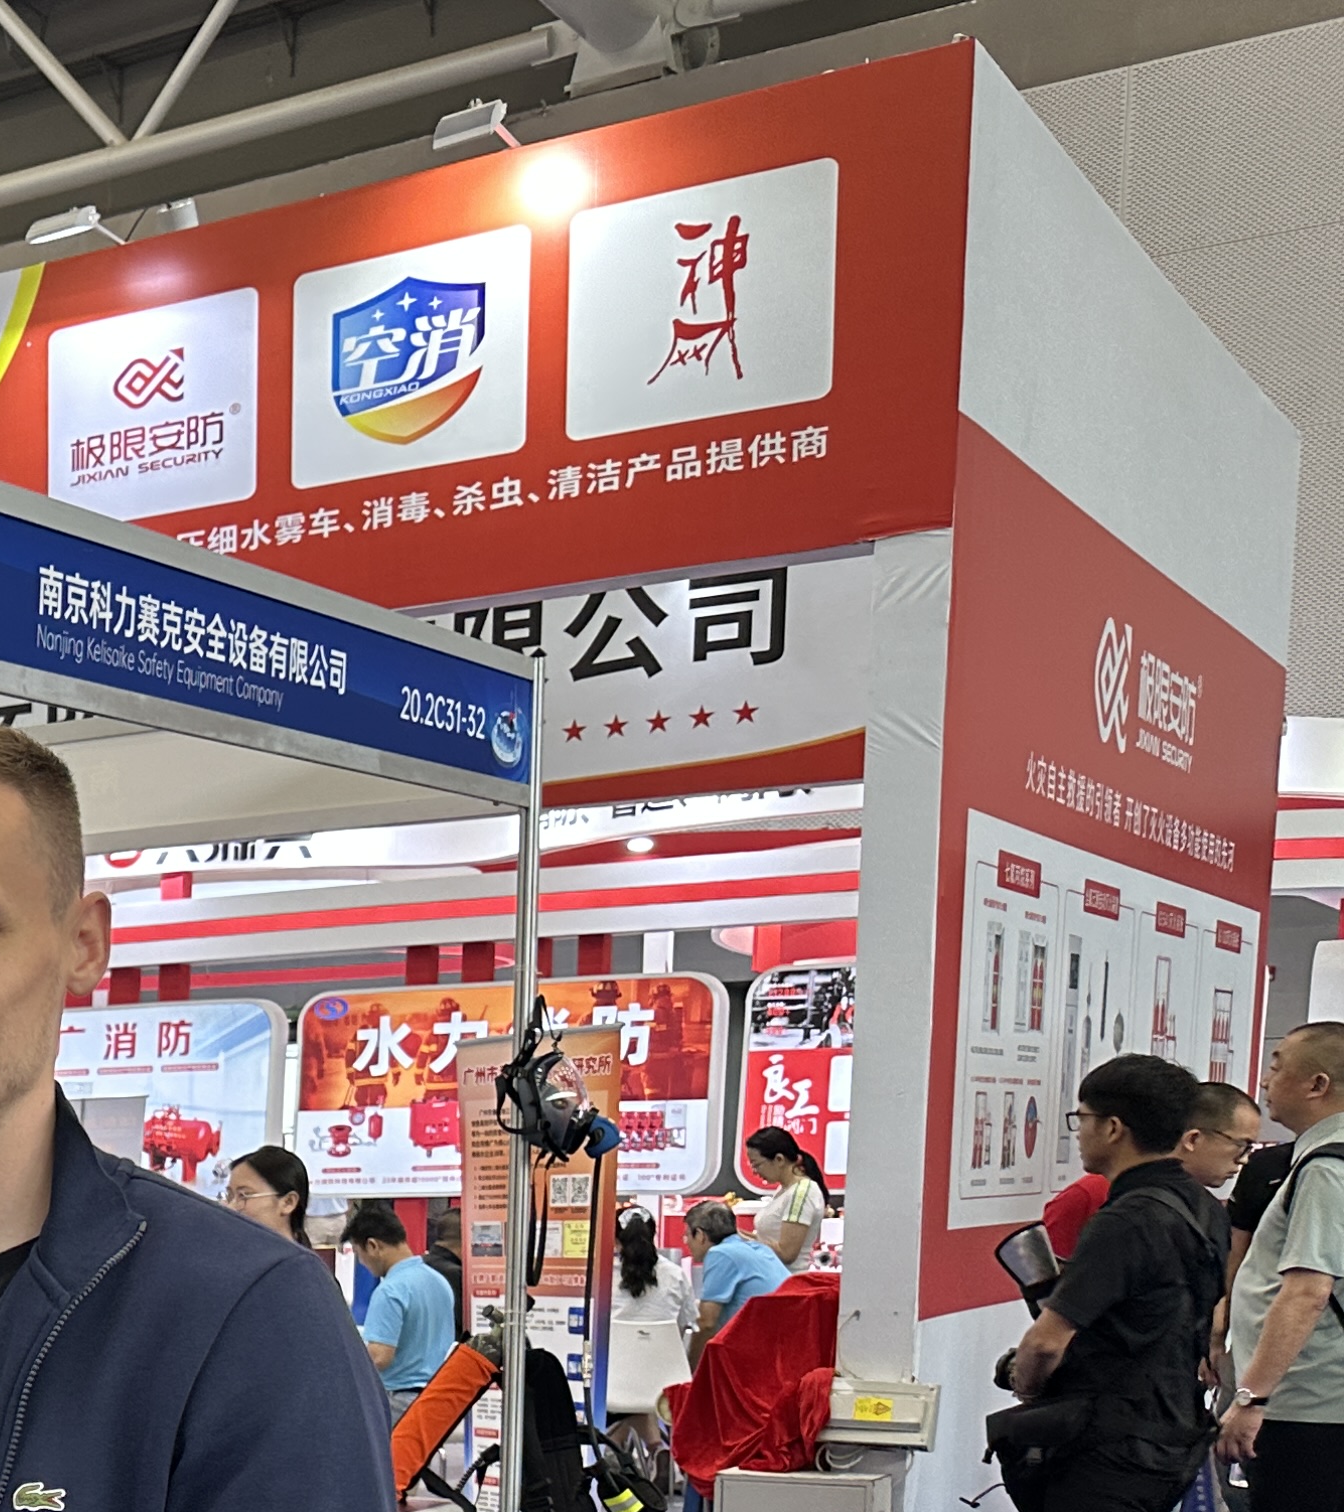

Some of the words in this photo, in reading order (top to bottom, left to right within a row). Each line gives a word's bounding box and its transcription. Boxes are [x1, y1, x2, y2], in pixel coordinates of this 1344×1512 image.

[341, 304, 483, 387] 空消
[339, 381, 421, 406] KONGXIAO
[69, 467, 129, 487] JIXIAN
[137, 447, 224, 474] SECURITY
[71, 411, 224, 469] 极限安防
[37, 563, 348, 696] 南京科力赛克安全设备有限公司
[36, 623, 83, 664] Nanjing
[86, 636, 135, 670] Kelisaike
[137, 649, 175, 686] Safety
[176, 659, 234, 697] Equipment
[235, 675, 284, 712] Company
[1138, 650, 1197, 746] 极限安防
[400, 685, 486, 741] 20.2C31-32
